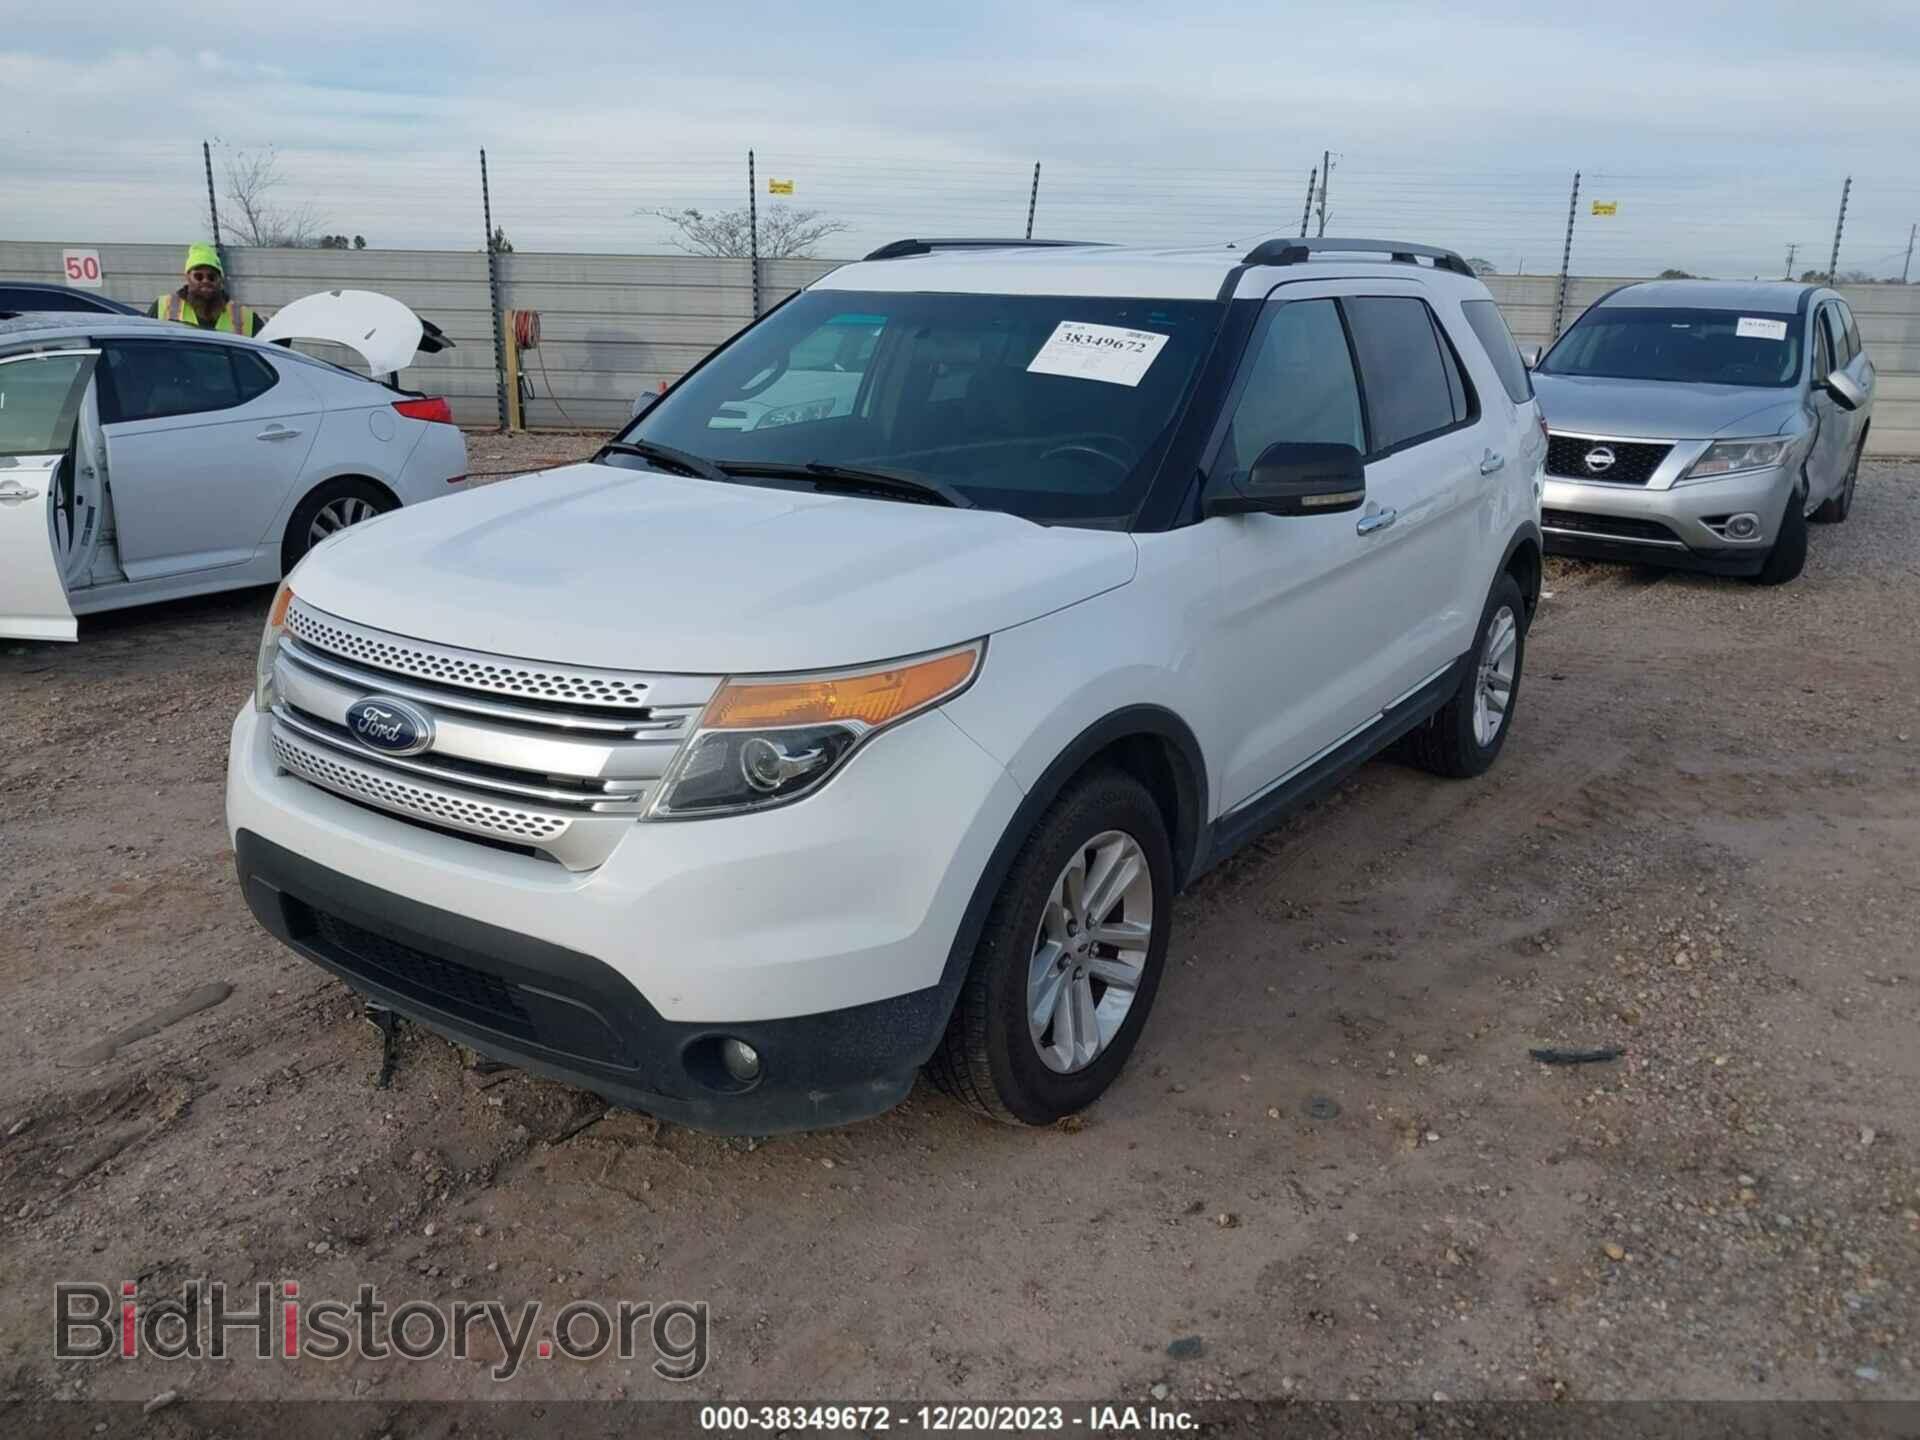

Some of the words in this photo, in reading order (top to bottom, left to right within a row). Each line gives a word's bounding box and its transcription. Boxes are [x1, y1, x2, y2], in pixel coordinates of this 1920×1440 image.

[66, 256, 98, 280] 50
[1060, 331, 1147, 353] 38349672
[357, 706, 402, 742] Ford
